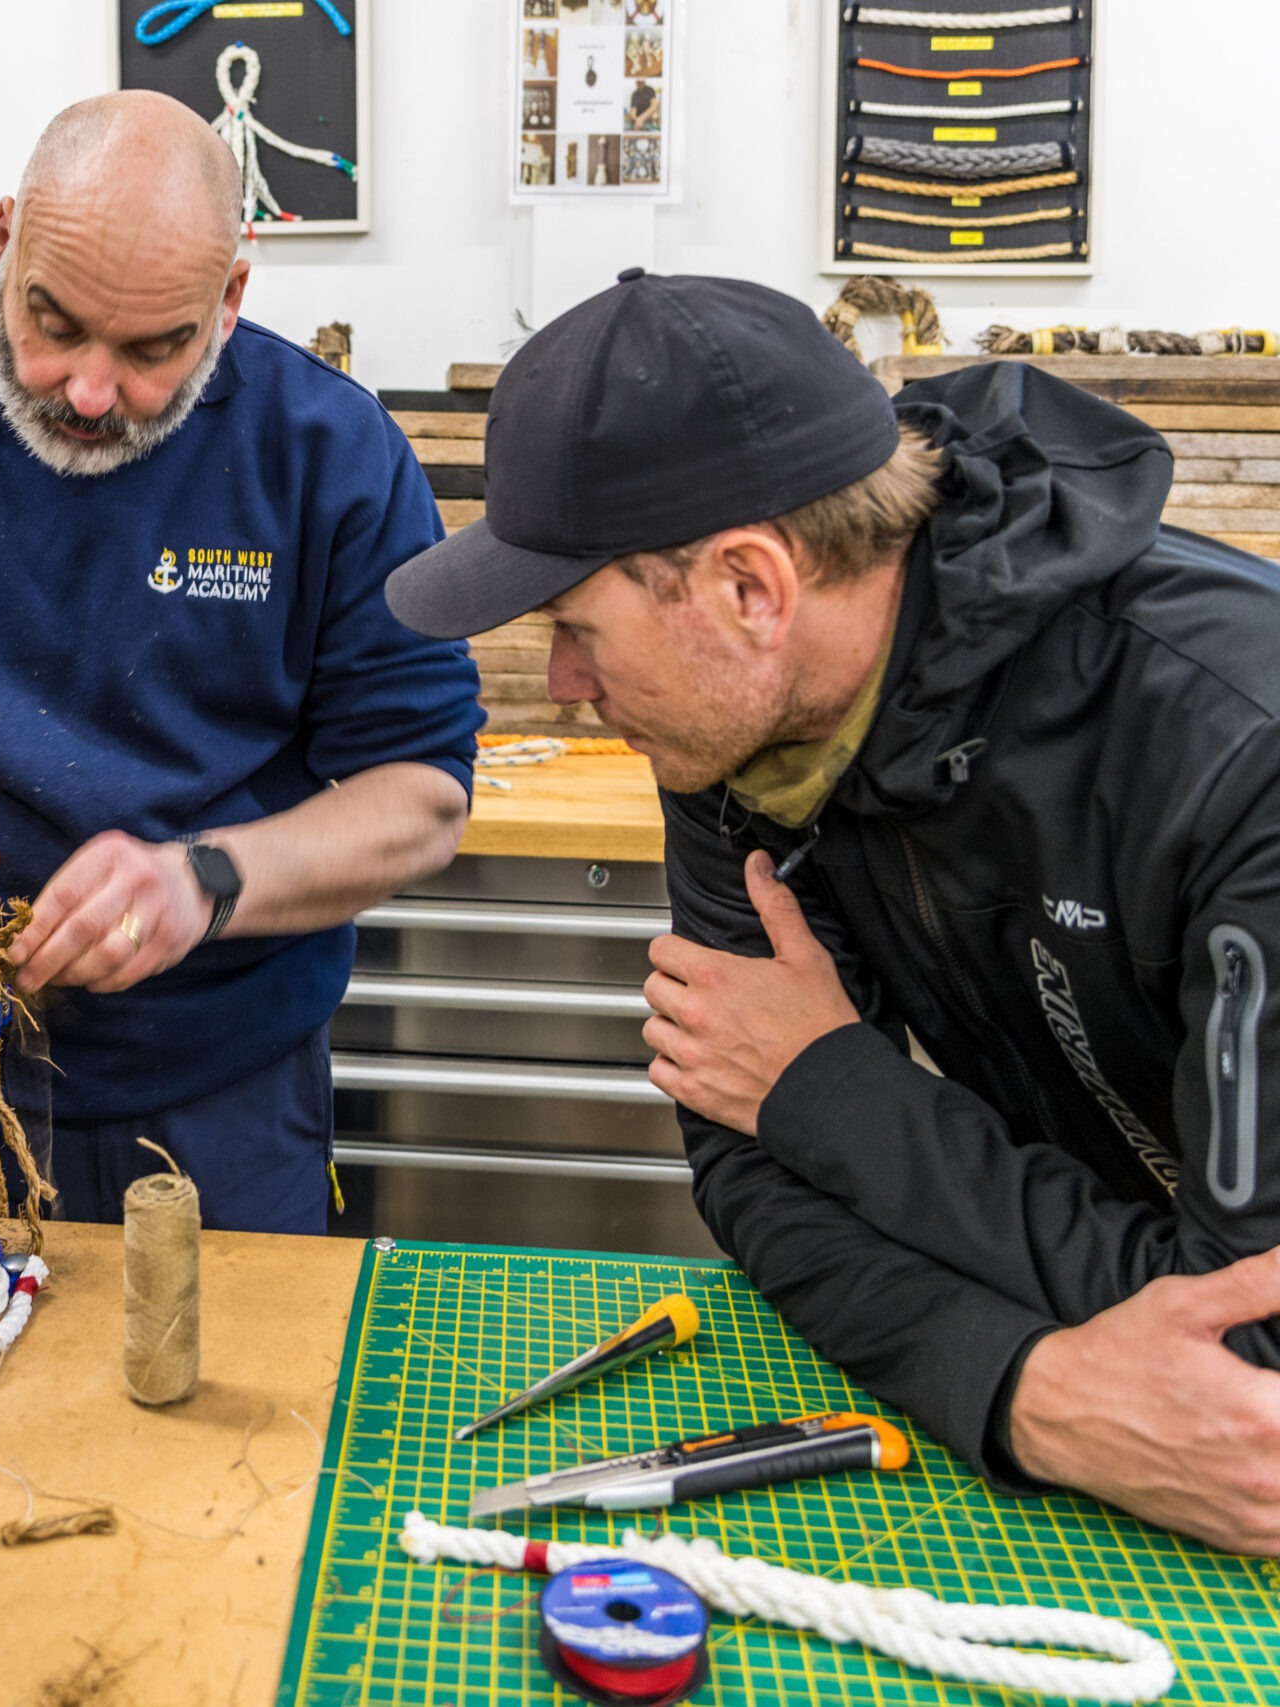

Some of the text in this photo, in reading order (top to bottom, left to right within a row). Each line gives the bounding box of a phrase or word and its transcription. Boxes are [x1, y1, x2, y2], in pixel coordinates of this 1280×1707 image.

[187, 547, 273, 568] SOUTH WEST
[187, 563, 272, 585] MARITIME
[186, 580, 271, 602] ACADEMY
[1042, 893, 1107, 930] CMP
